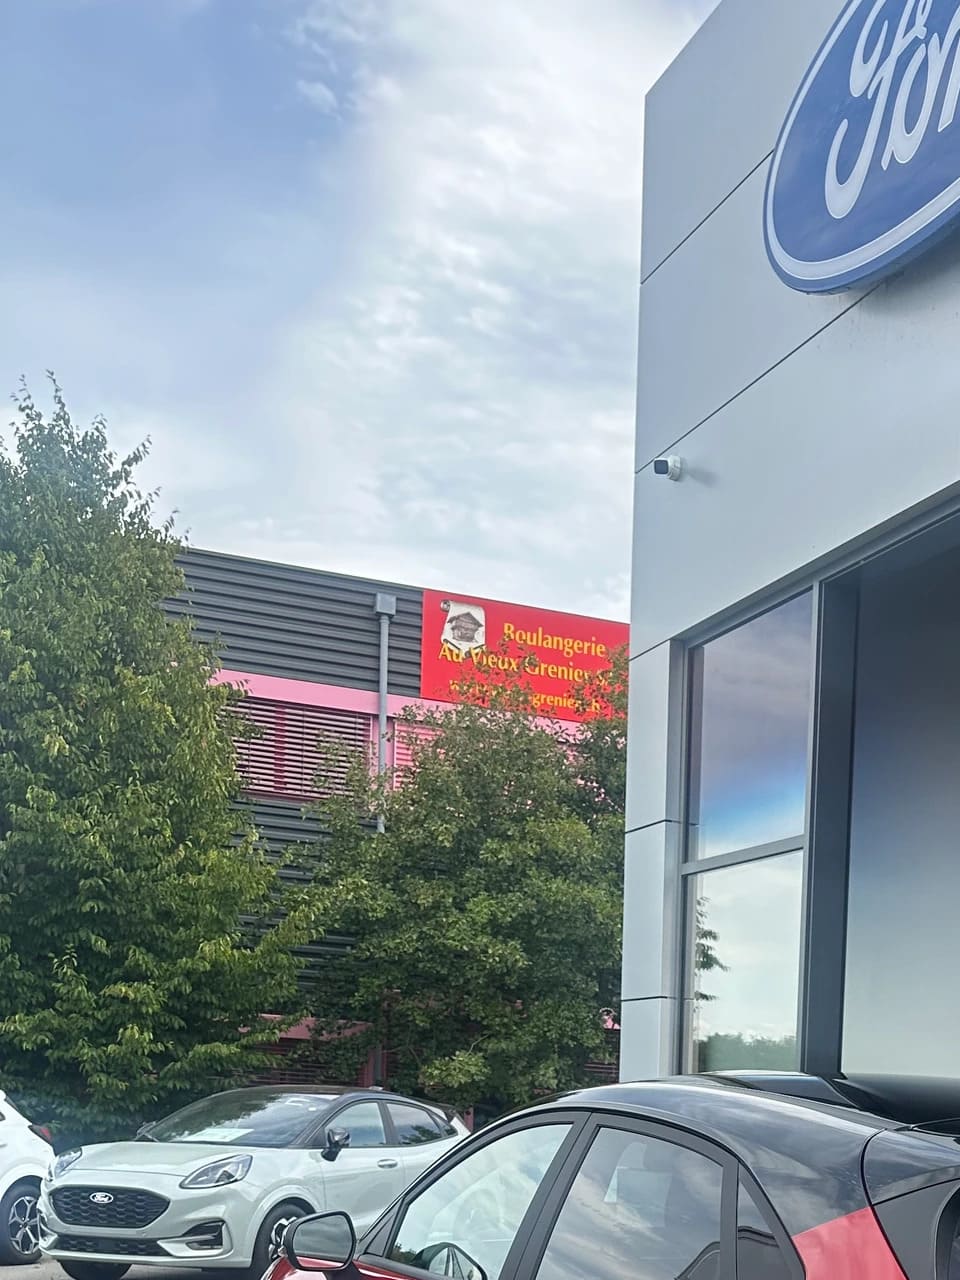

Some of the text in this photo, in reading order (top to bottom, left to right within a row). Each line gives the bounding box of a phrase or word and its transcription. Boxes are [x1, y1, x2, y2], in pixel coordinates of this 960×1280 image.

[503, 622, 606, 658] Boulangerie
[438, 642, 464, 663] Au
[470, 645, 519, 673] Vieux
